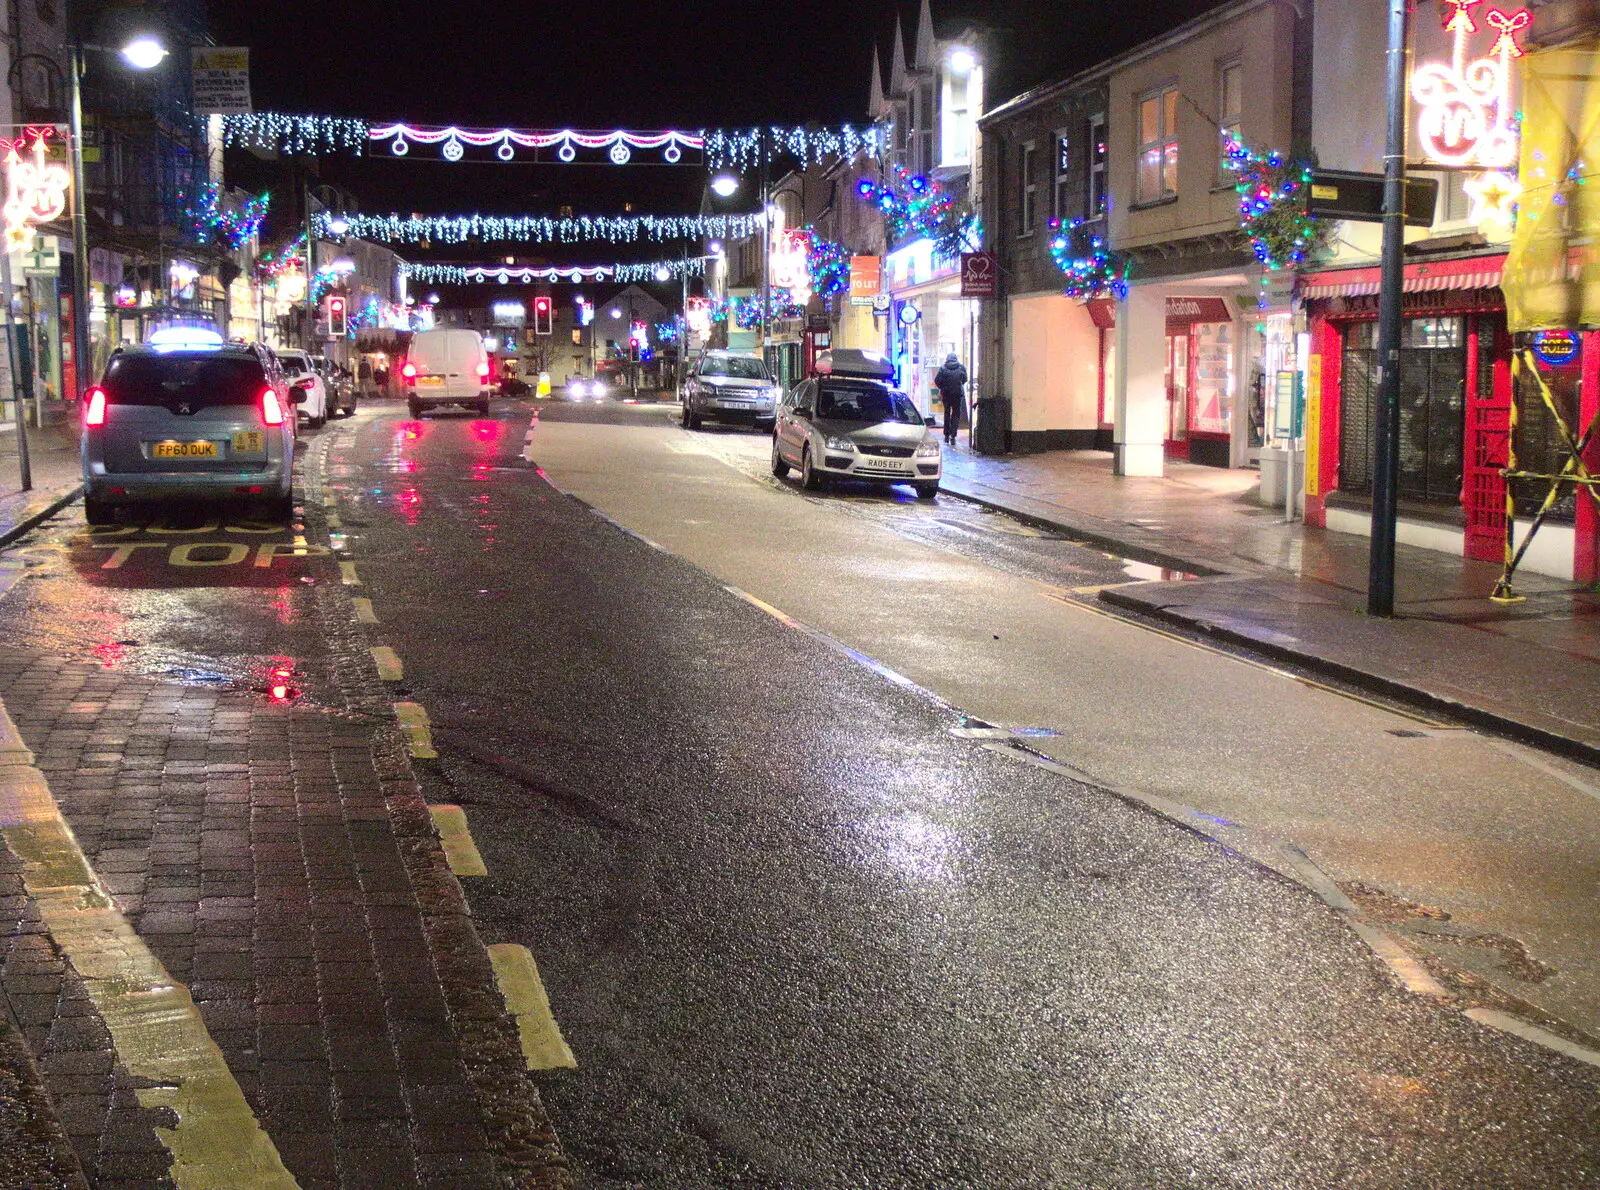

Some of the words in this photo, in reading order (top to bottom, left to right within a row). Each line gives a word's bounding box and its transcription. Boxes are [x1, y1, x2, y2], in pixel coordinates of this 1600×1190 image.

[25, 268, 56, 276] Pharmacy
[851, 280, 862, 289] TO
[863, 280, 877, 289] LET
[1540, 338, 1574, 354] GOLD
[158, 444, 188, 456] FP60
[868, 459, 887, 468] RA05
[888, 461, 903, 469] EEY
